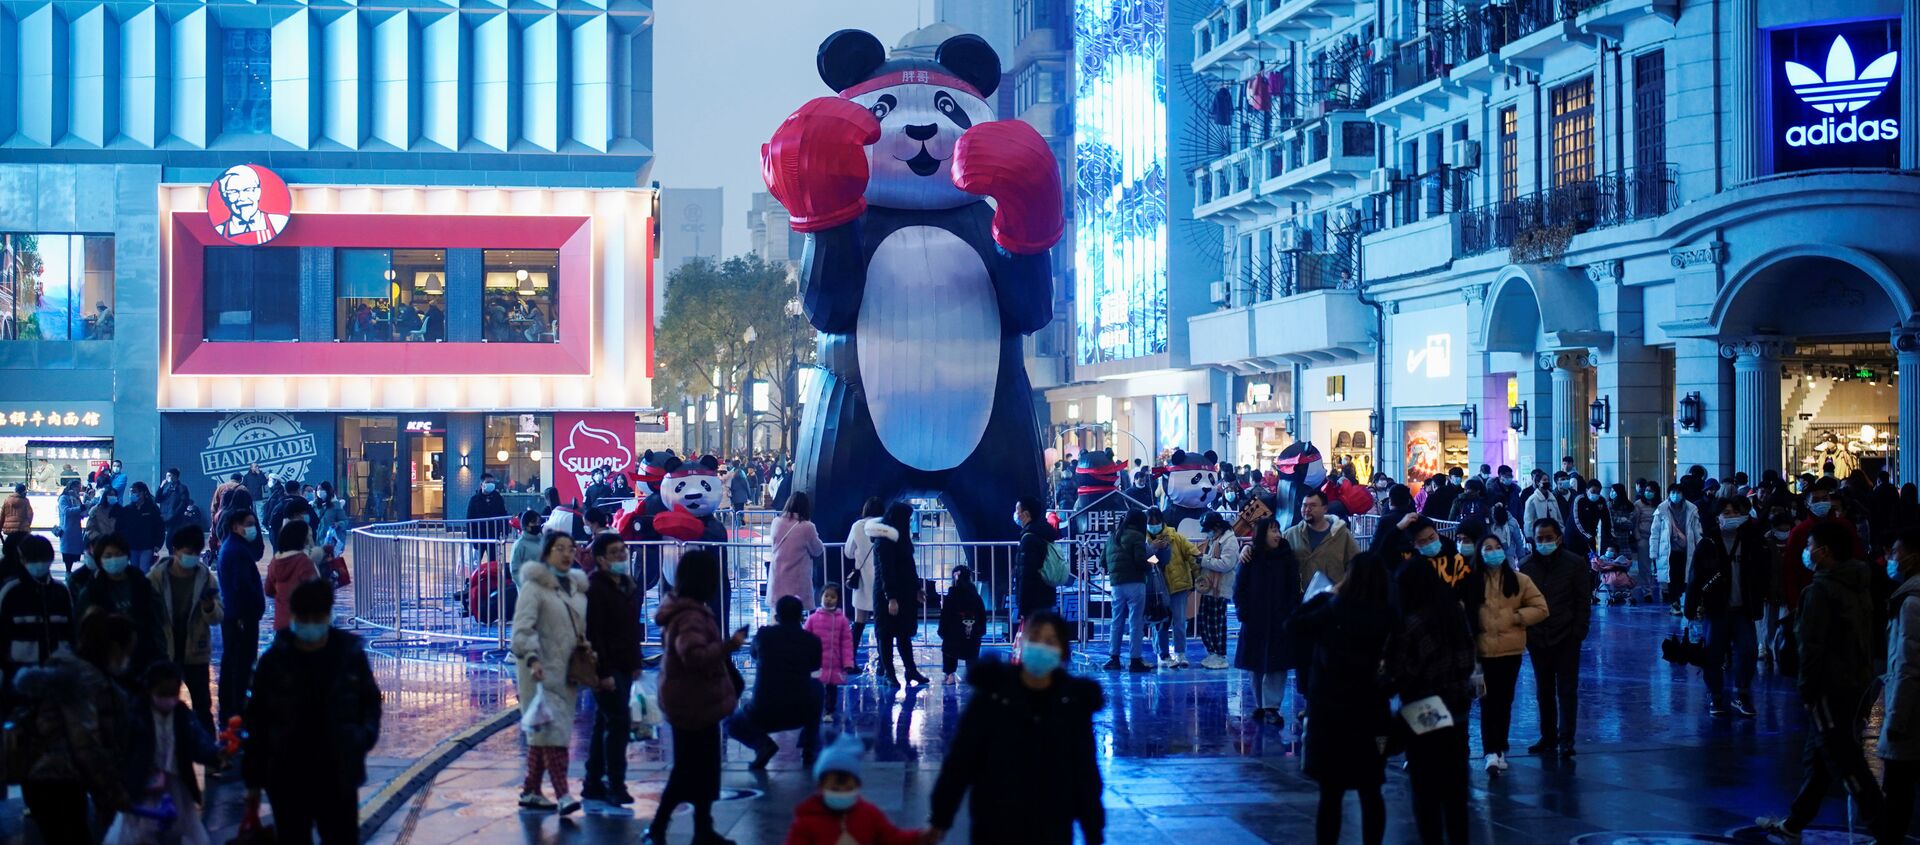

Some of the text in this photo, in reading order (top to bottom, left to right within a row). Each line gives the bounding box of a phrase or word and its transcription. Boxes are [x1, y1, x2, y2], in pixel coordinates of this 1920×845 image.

[902, 70, 929, 83] 胖哥
[1785, 115, 1899, 147] adidas
[232, 415, 276, 431] FRESHLY
[406, 421, 432, 430] KFC
[204, 438, 313, 471] HANDMADE
